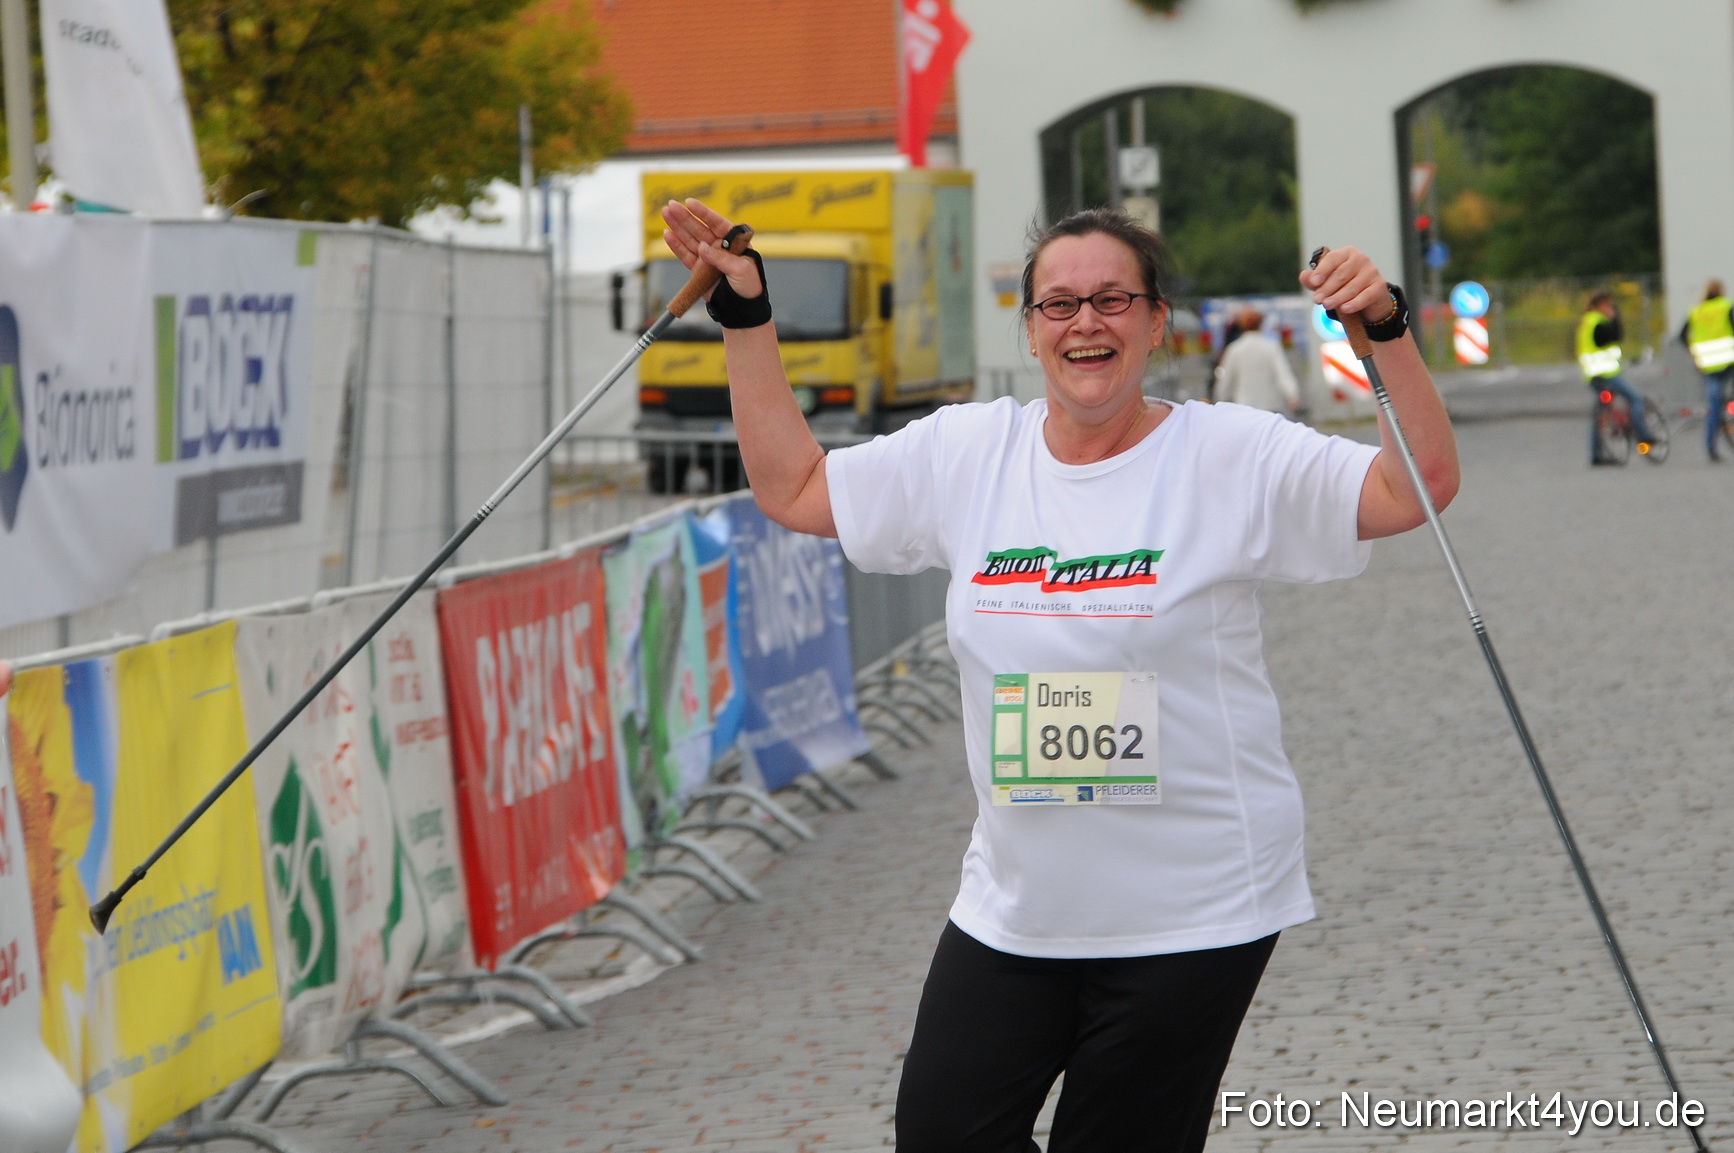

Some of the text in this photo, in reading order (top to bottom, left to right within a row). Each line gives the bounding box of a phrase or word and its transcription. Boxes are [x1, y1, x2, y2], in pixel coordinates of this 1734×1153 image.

[1047, 554, 1153, 586] ITALIA
[976, 599, 1154, 613] FEINE ITALIENISCHE SPEZIALITÄTEN
[1037, 683, 1092, 708] Doris
[1040, 724, 1144, 761] 8062
[1010, 785, 1158, 799] BOCK PFLEIDERER
